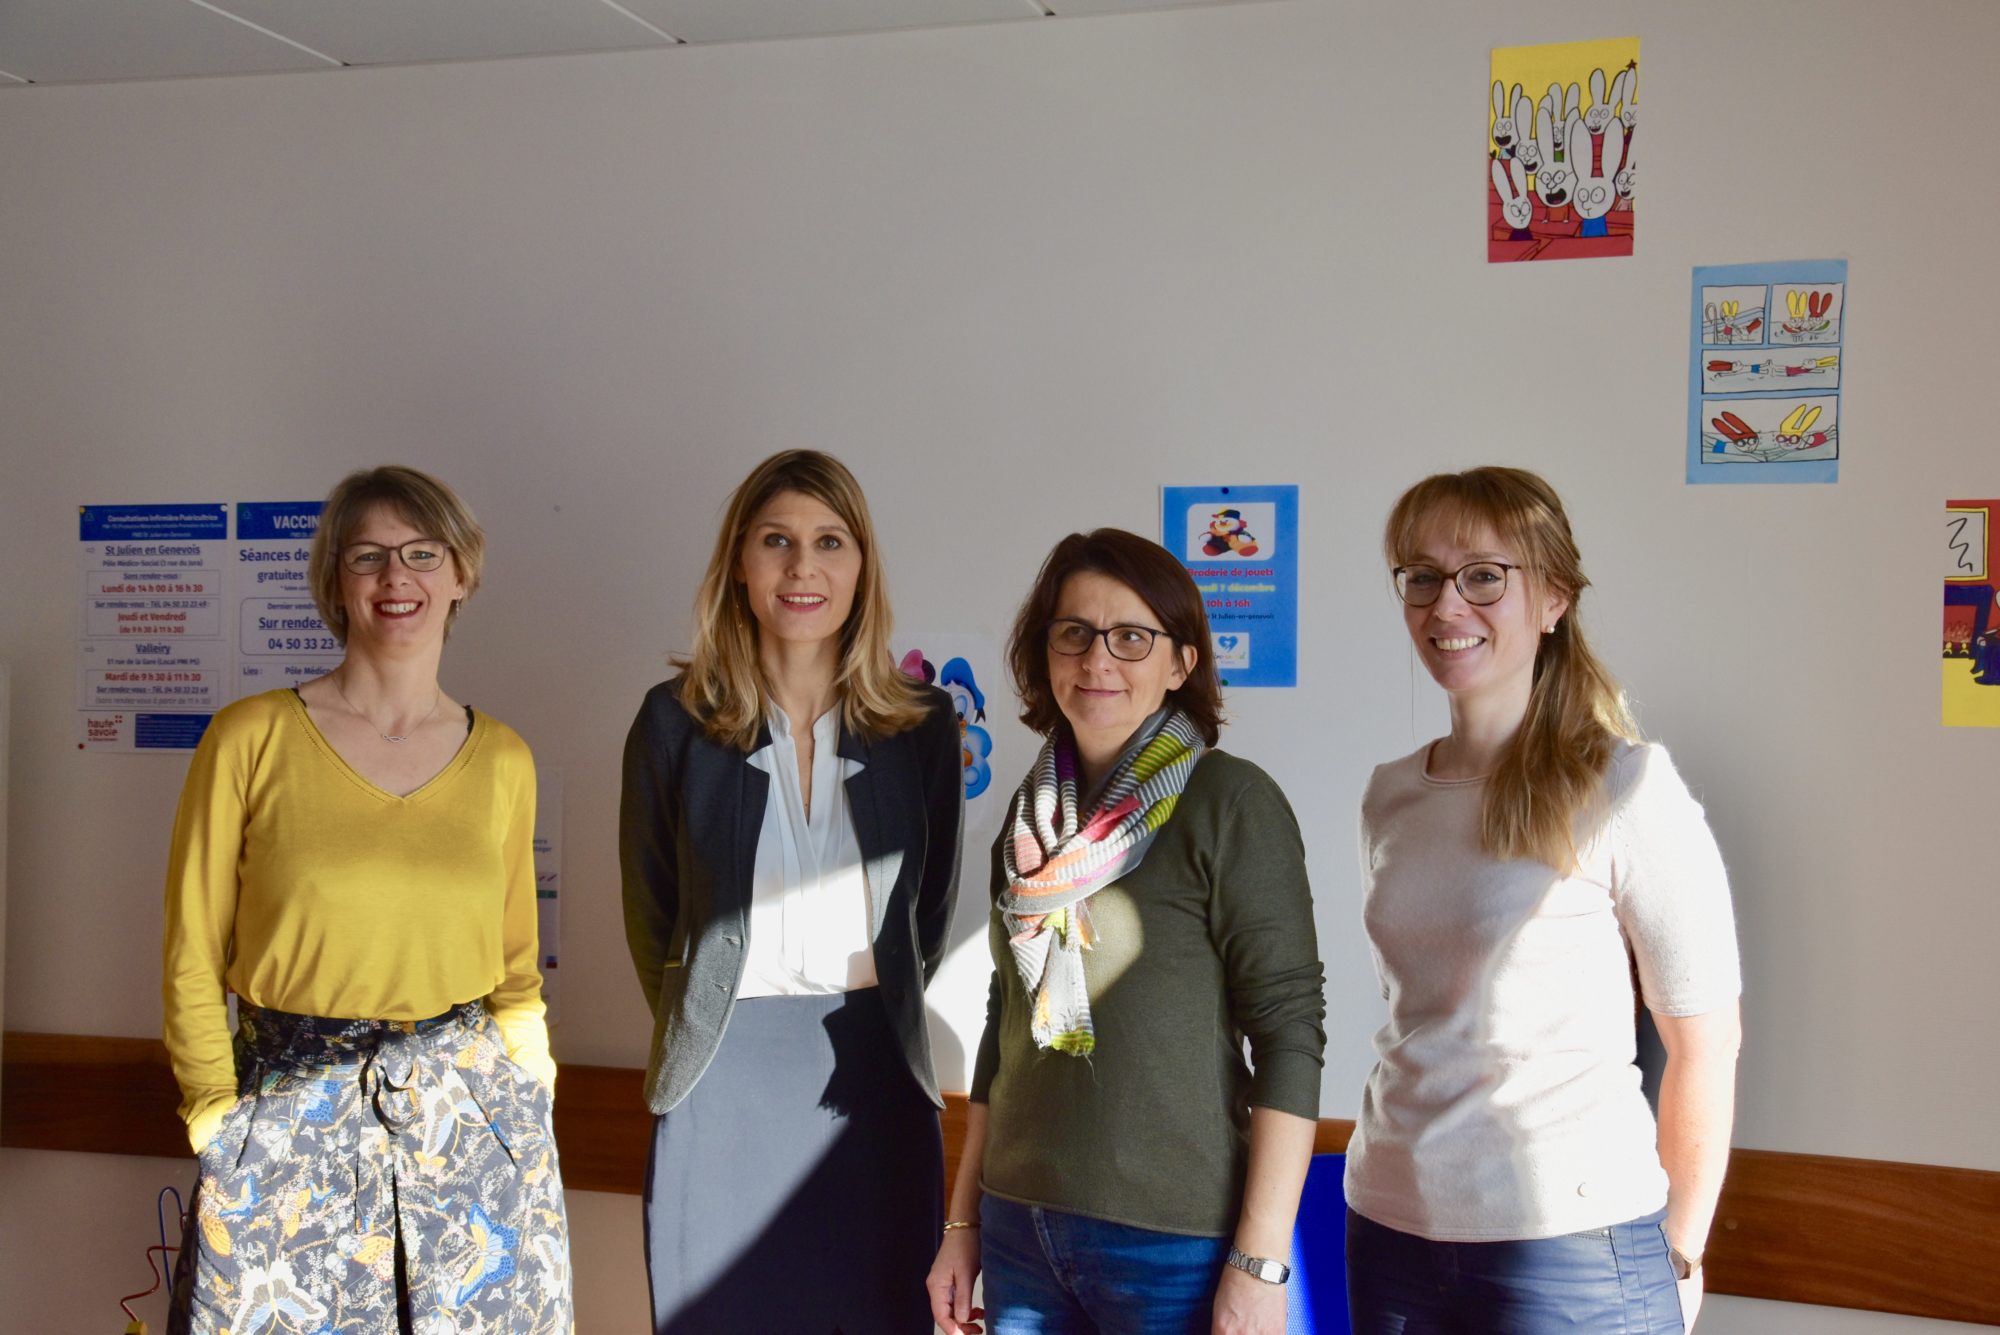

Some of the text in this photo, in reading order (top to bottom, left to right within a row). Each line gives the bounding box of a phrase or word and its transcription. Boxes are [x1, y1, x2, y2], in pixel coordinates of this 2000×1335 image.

[105, 546, 114, 556] St
[116, 544, 142, 556] Julien
[158, 544, 200, 555] Genevois
[240, 548, 310, 562] Séances de
[257, 569, 304, 583] gratuites
[1231, 568, 1242, 576] de
[1245, 568, 1273, 578] jouets
[102, 584, 203, 592] Lundi de 14 h 00 à 16 h 30
[1228, 583, 1276, 592] décembre
[1207, 599, 1222, 608] 10h
[118, 612, 186, 622] Jeudi et Vendredi
[258, 616, 278, 628] Sur
[136, 642, 170, 654] Valleiry
[268, 638, 282, 650] 04
[286, 638, 300, 650] 50
[304, 638, 317, 650] 33
[320, 638, 334, 650] 23
[285, 666, 302, 675] Pôle
[105, 672, 200, 682] Mardi de 9 h 30 à 11 h 30
[88, 718, 114, 728] haute
[88, 728, 118, 737] savoie
